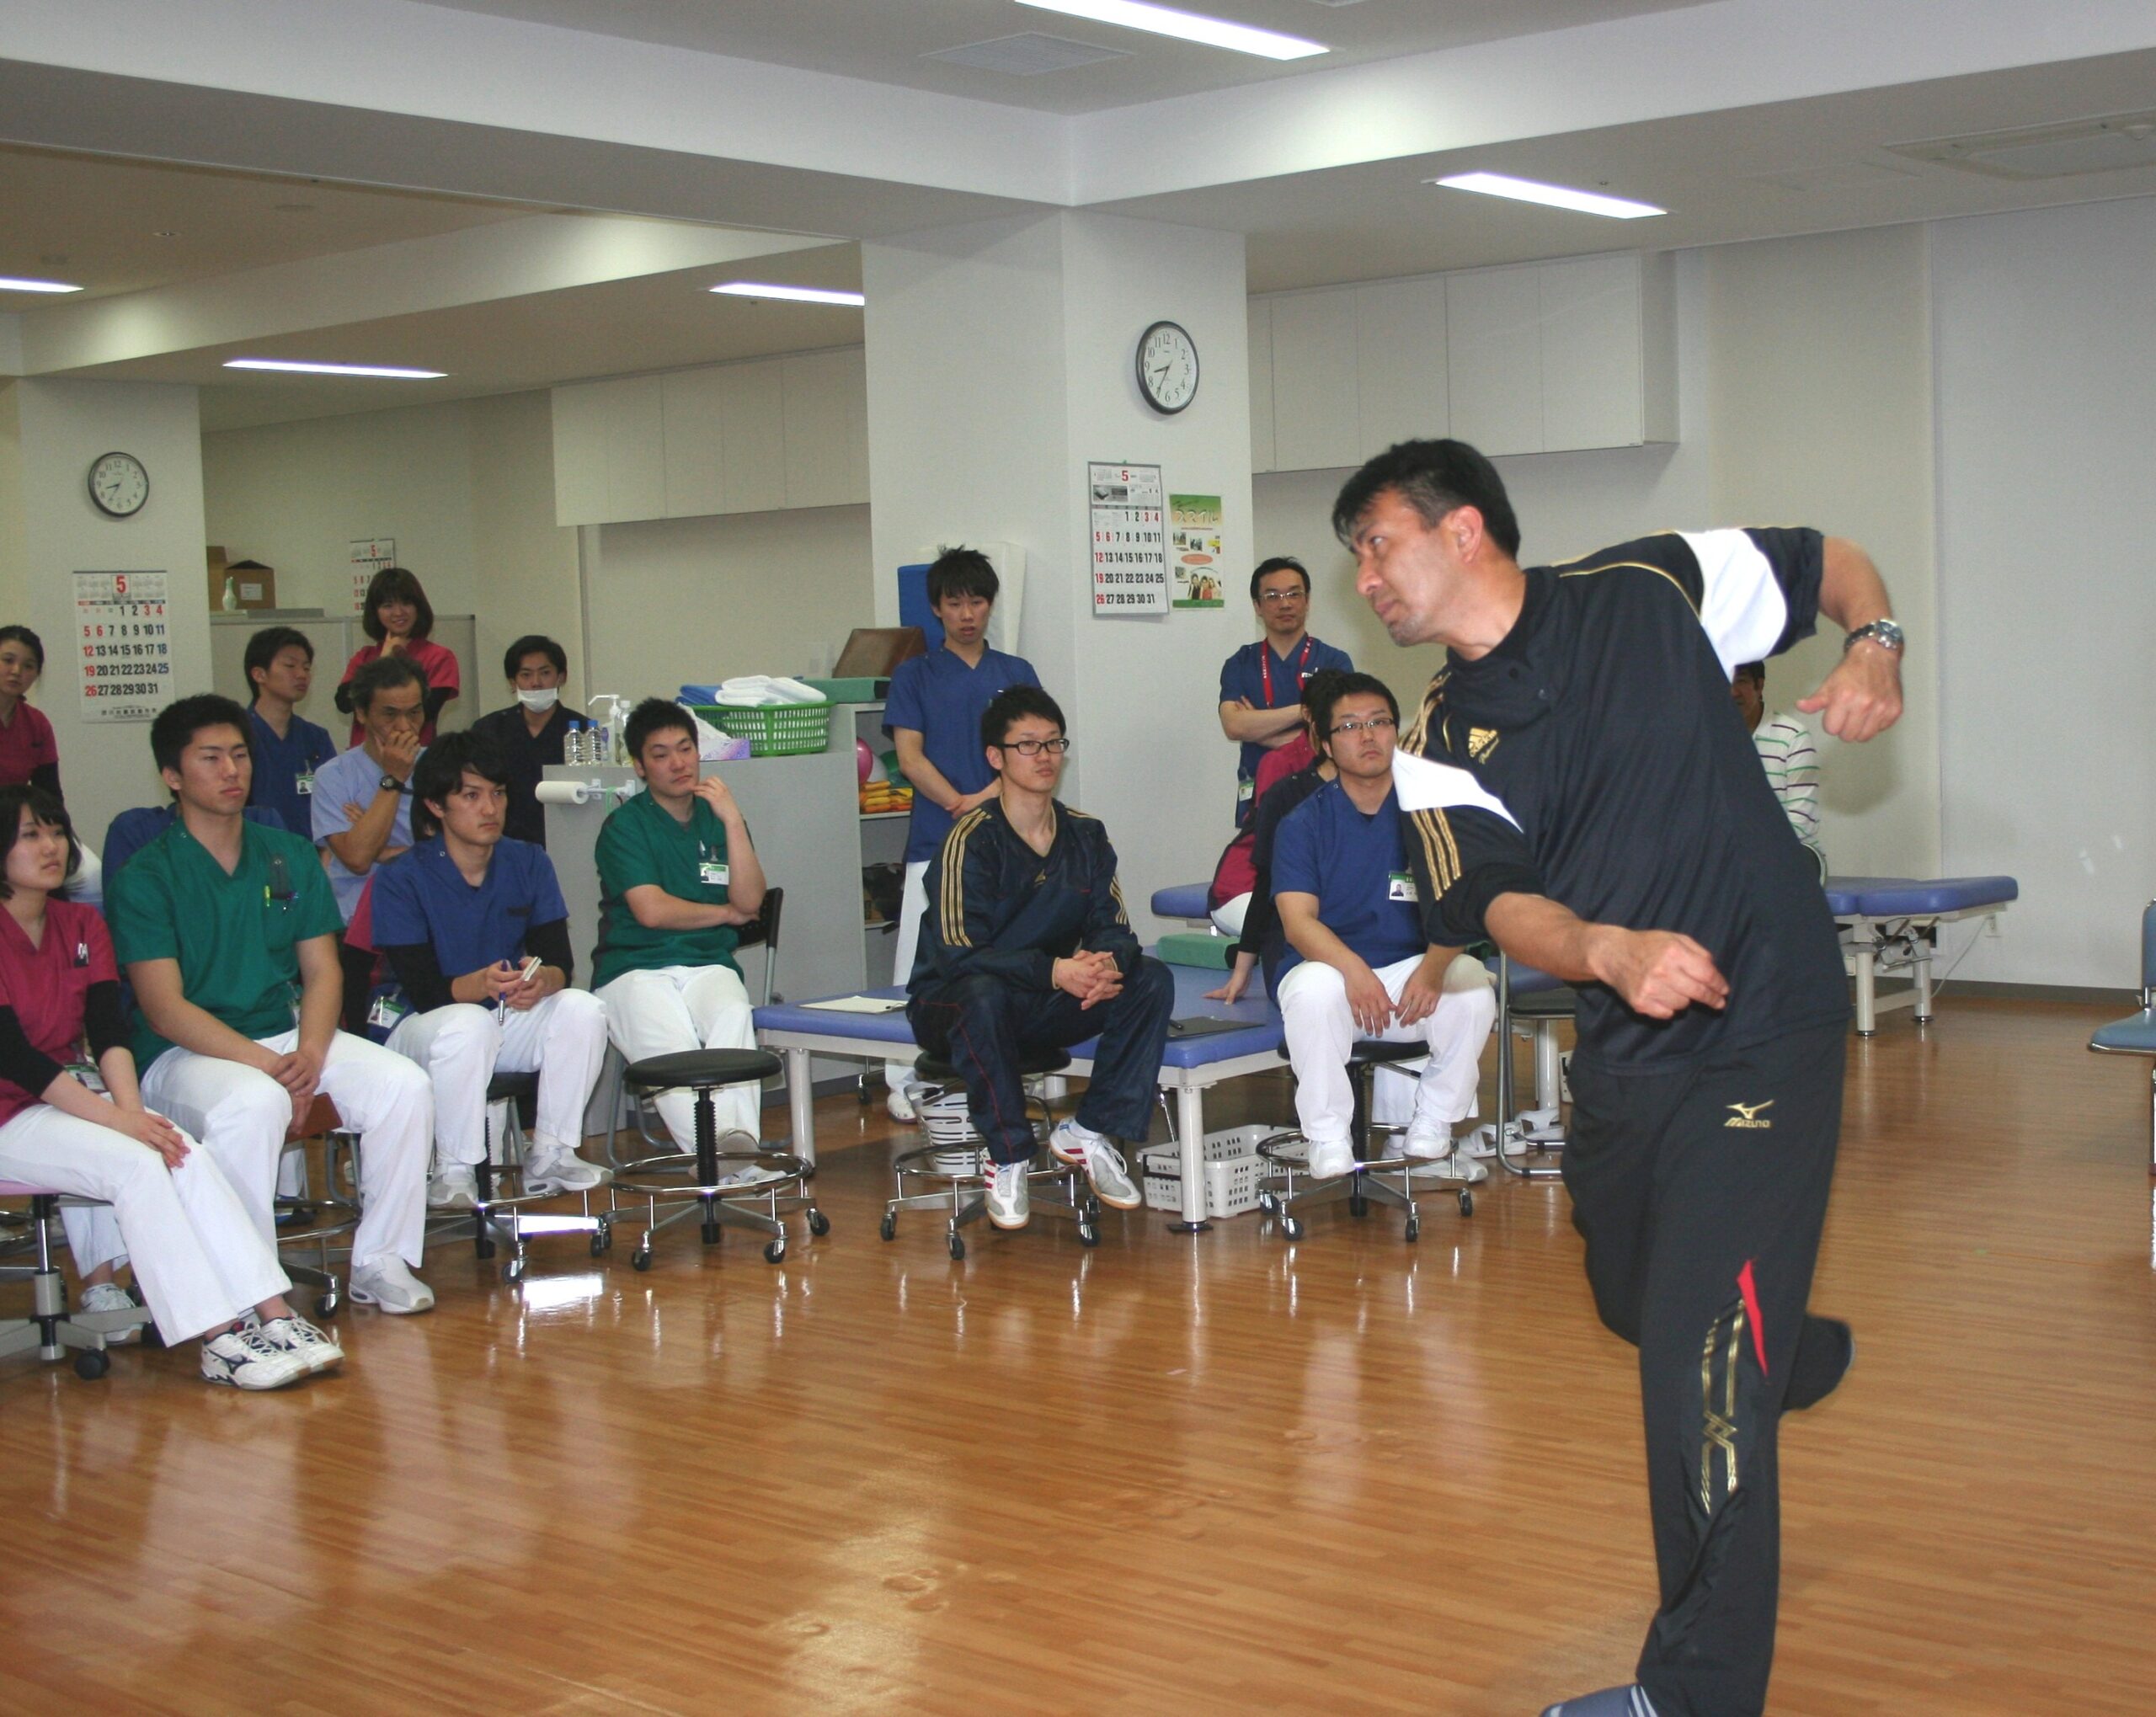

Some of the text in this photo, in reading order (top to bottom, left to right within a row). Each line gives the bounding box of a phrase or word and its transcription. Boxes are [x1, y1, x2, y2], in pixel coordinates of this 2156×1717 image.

[1155, 338, 1161, 348] 11
[1163, 333, 1171, 344] 12
[1148, 347, 1155, 357] 10
[1182, 349, 1185, 360] 2
[1145, 361, 1150, 371] 9
[1185, 364, 1189, 375] 3
[1148, 376, 1153, 387] 8
[1181, 379, 1185, 390] 4
[1166, 391, 1170, 402] 6
[1175, 388, 1179, 397] 5
[1122, 471, 1129, 481] 5
[1125, 512, 1129, 521] 1
[1135, 512, 1139, 521] 2
[1145, 512, 1149, 521] 3
[1155, 513, 1159, 521] 4
[1096, 532, 1161, 542] 5 6 7 8 9 10 11
[1095, 552, 1162, 563] 12 13 14 15 16 17 18
[1096, 573, 1164, 583] 19 20 21 22 23 24 25
[116, 575, 125, 593] 5
[1097, 594, 1155, 604] 26 27 28 29 30 31
[120, 606, 124, 616] 1
[132, 605, 138, 616] 2
[144, 605, 150, 616] 3
[157, 605, 163, 615] 4
[84, 624, 164, 637] 5 6 7 8 9 10 11
[83, 643, 167, 656] 12 13 14 15 16 17 18
[84, 664, 168, 676] 19 20 21 22 23 24 25
[85, 683, 157, 696] 26 27 28 29 30 31
